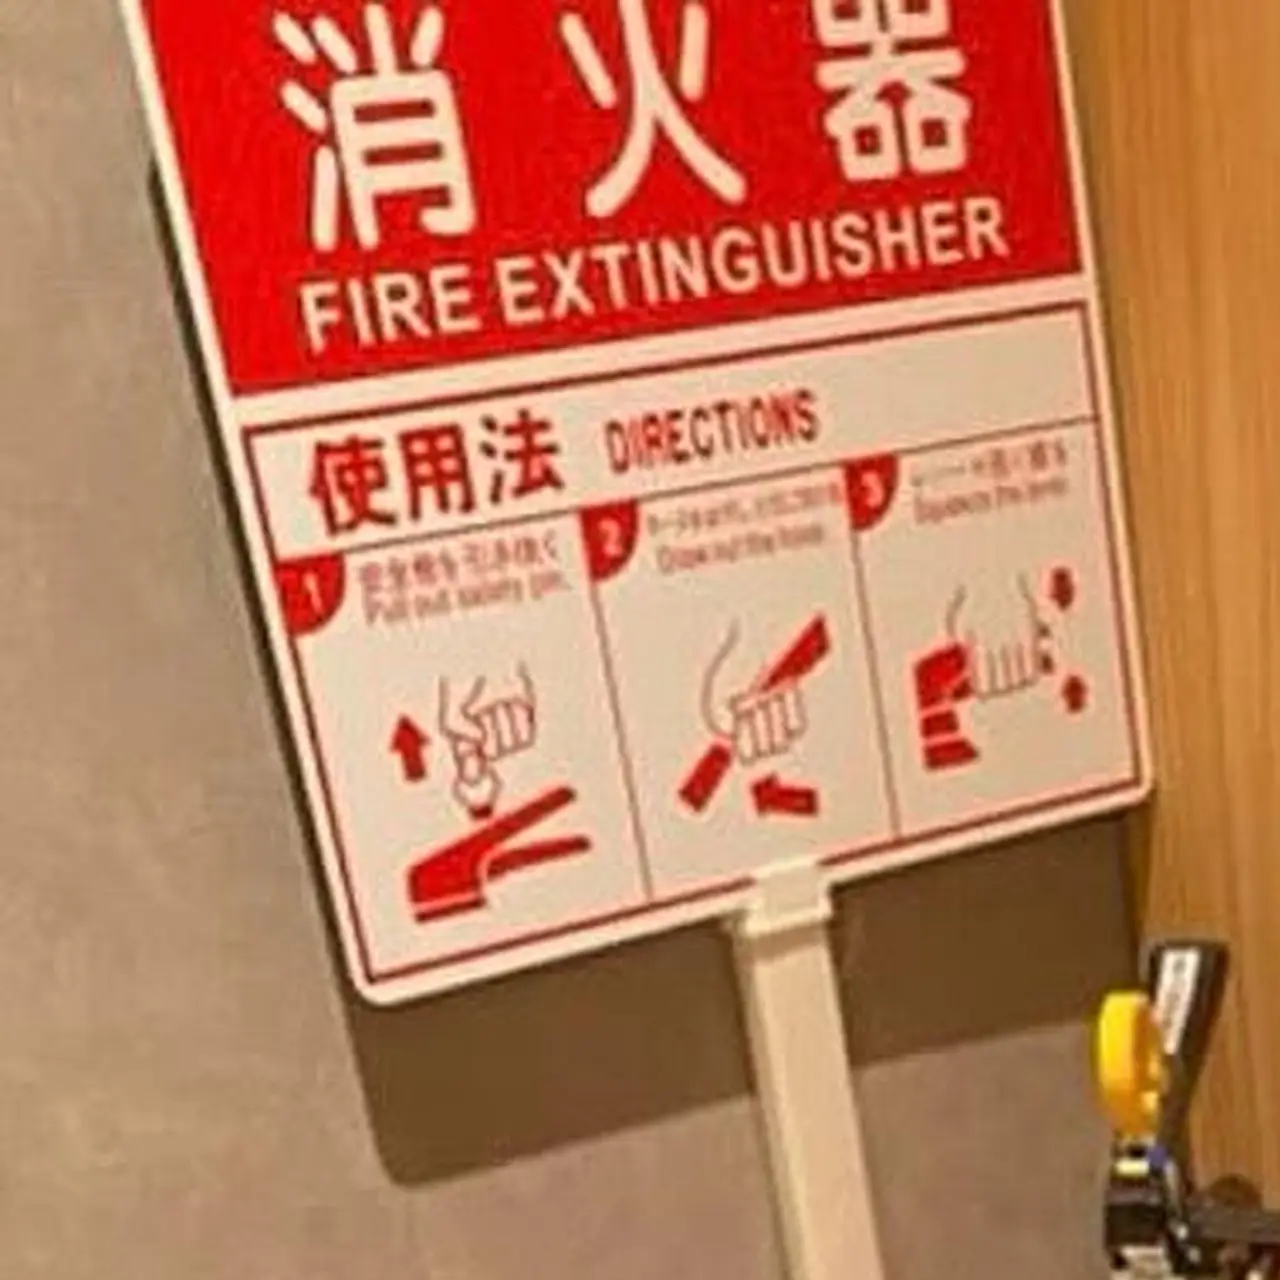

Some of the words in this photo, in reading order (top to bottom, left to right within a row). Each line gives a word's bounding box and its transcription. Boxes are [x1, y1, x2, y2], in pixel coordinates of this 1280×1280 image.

[274, 0, 973, 251] 消火器
[300, 262, 480, 353] FIRE
[499, 196, 1009, 326] EXTINGUISHER
[309, 410, 565, 536] 使用法
[605, 389, 819, 474] DIRECTIONS
[862, 470, 886, 507] 3
[599, 518, 622, 556] 2
[304, 571, 324, 616] 1
